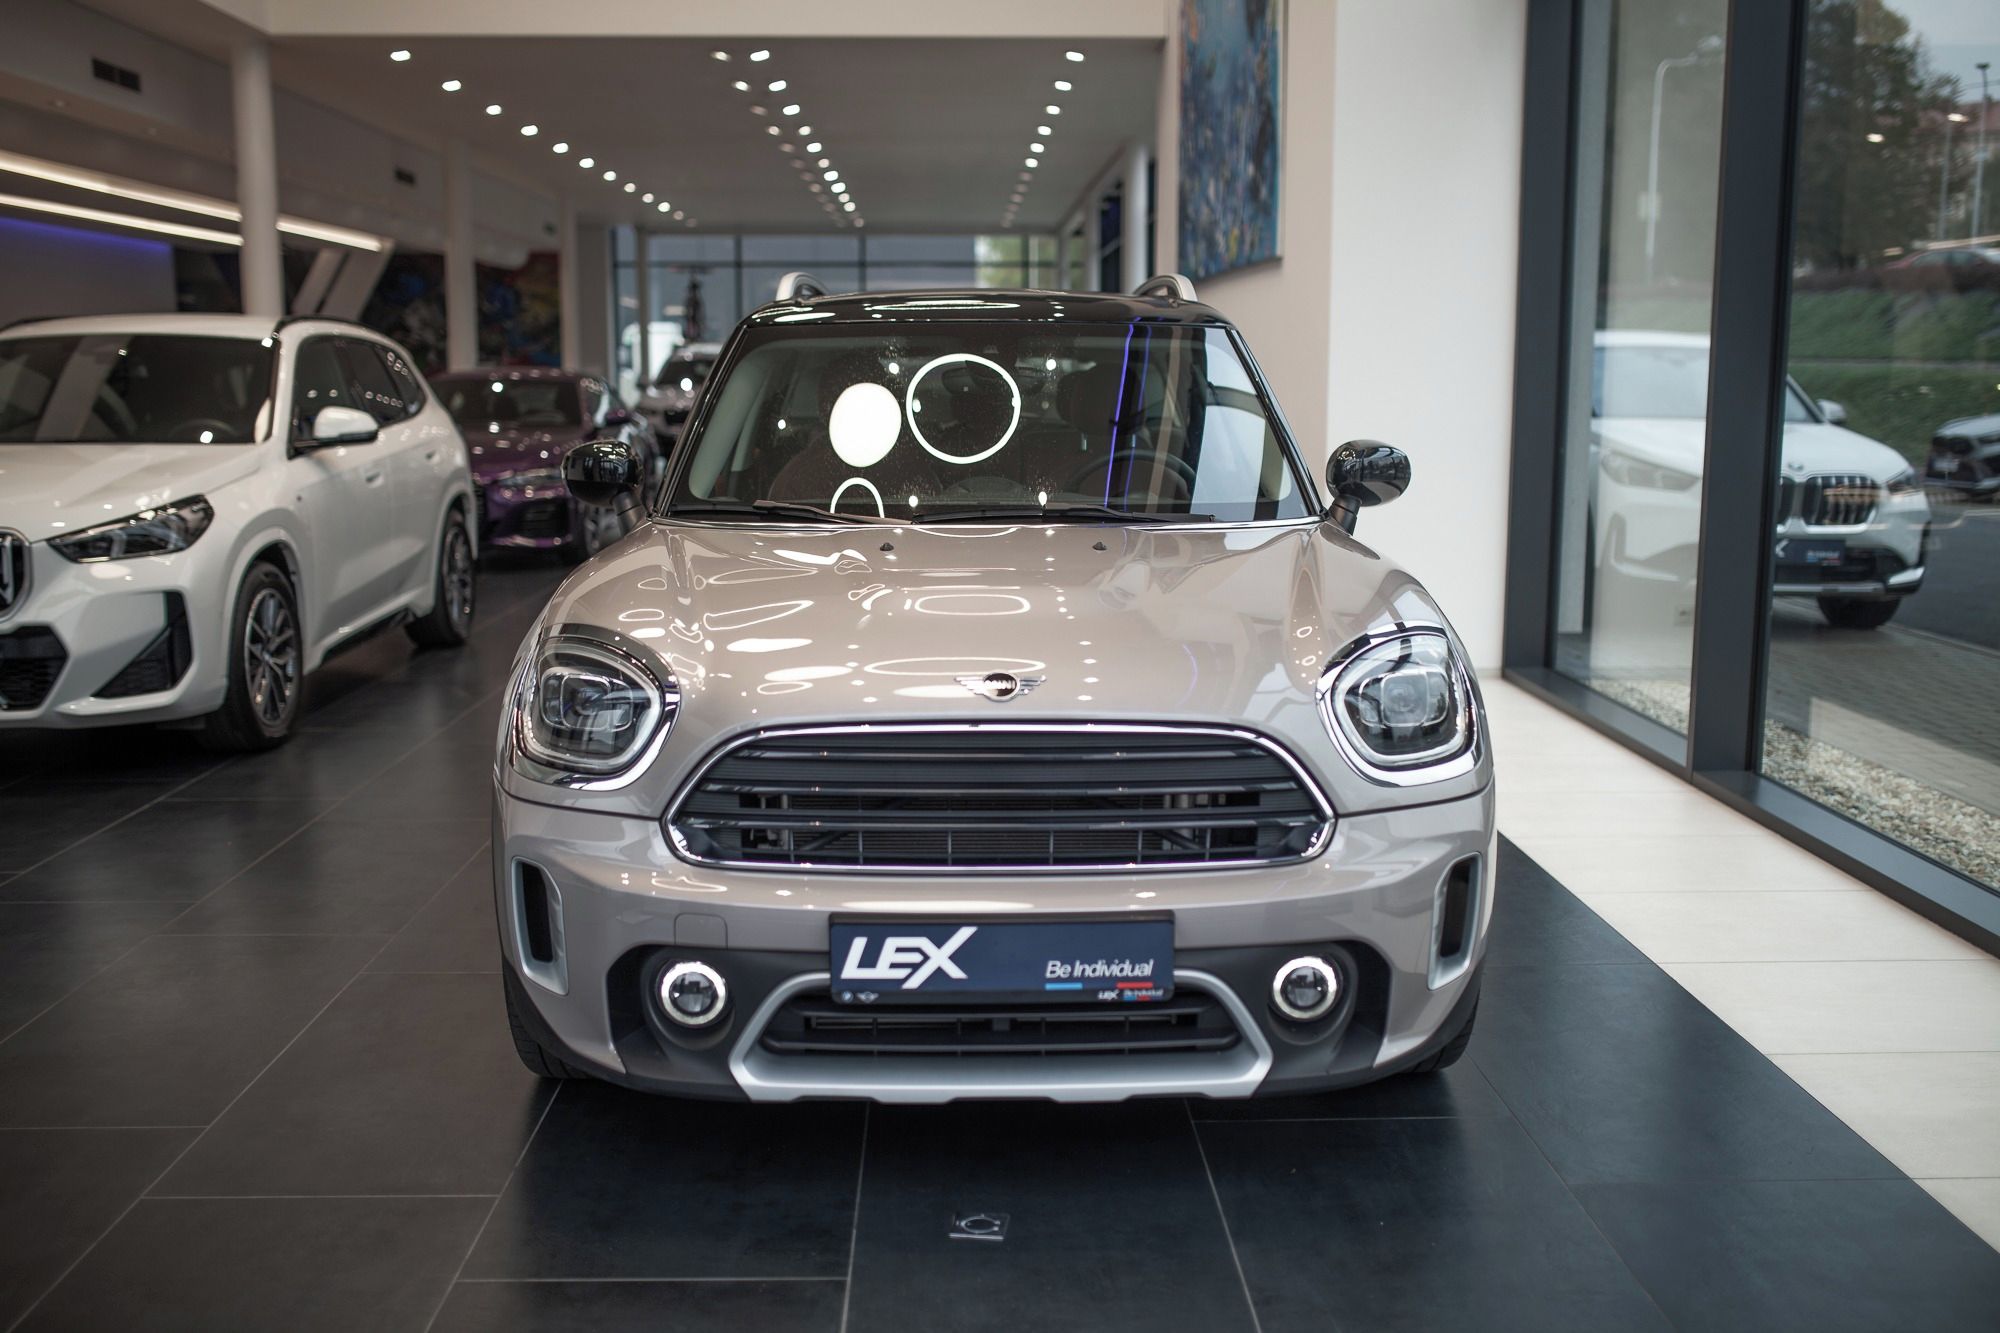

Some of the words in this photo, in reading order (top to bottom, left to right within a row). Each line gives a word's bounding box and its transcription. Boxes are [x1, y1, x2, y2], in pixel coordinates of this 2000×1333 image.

[841, 926, 978, 989] LEX
[1045, 960, 1072, 979] Be
[1073, 959, 1154, 978] Individual
